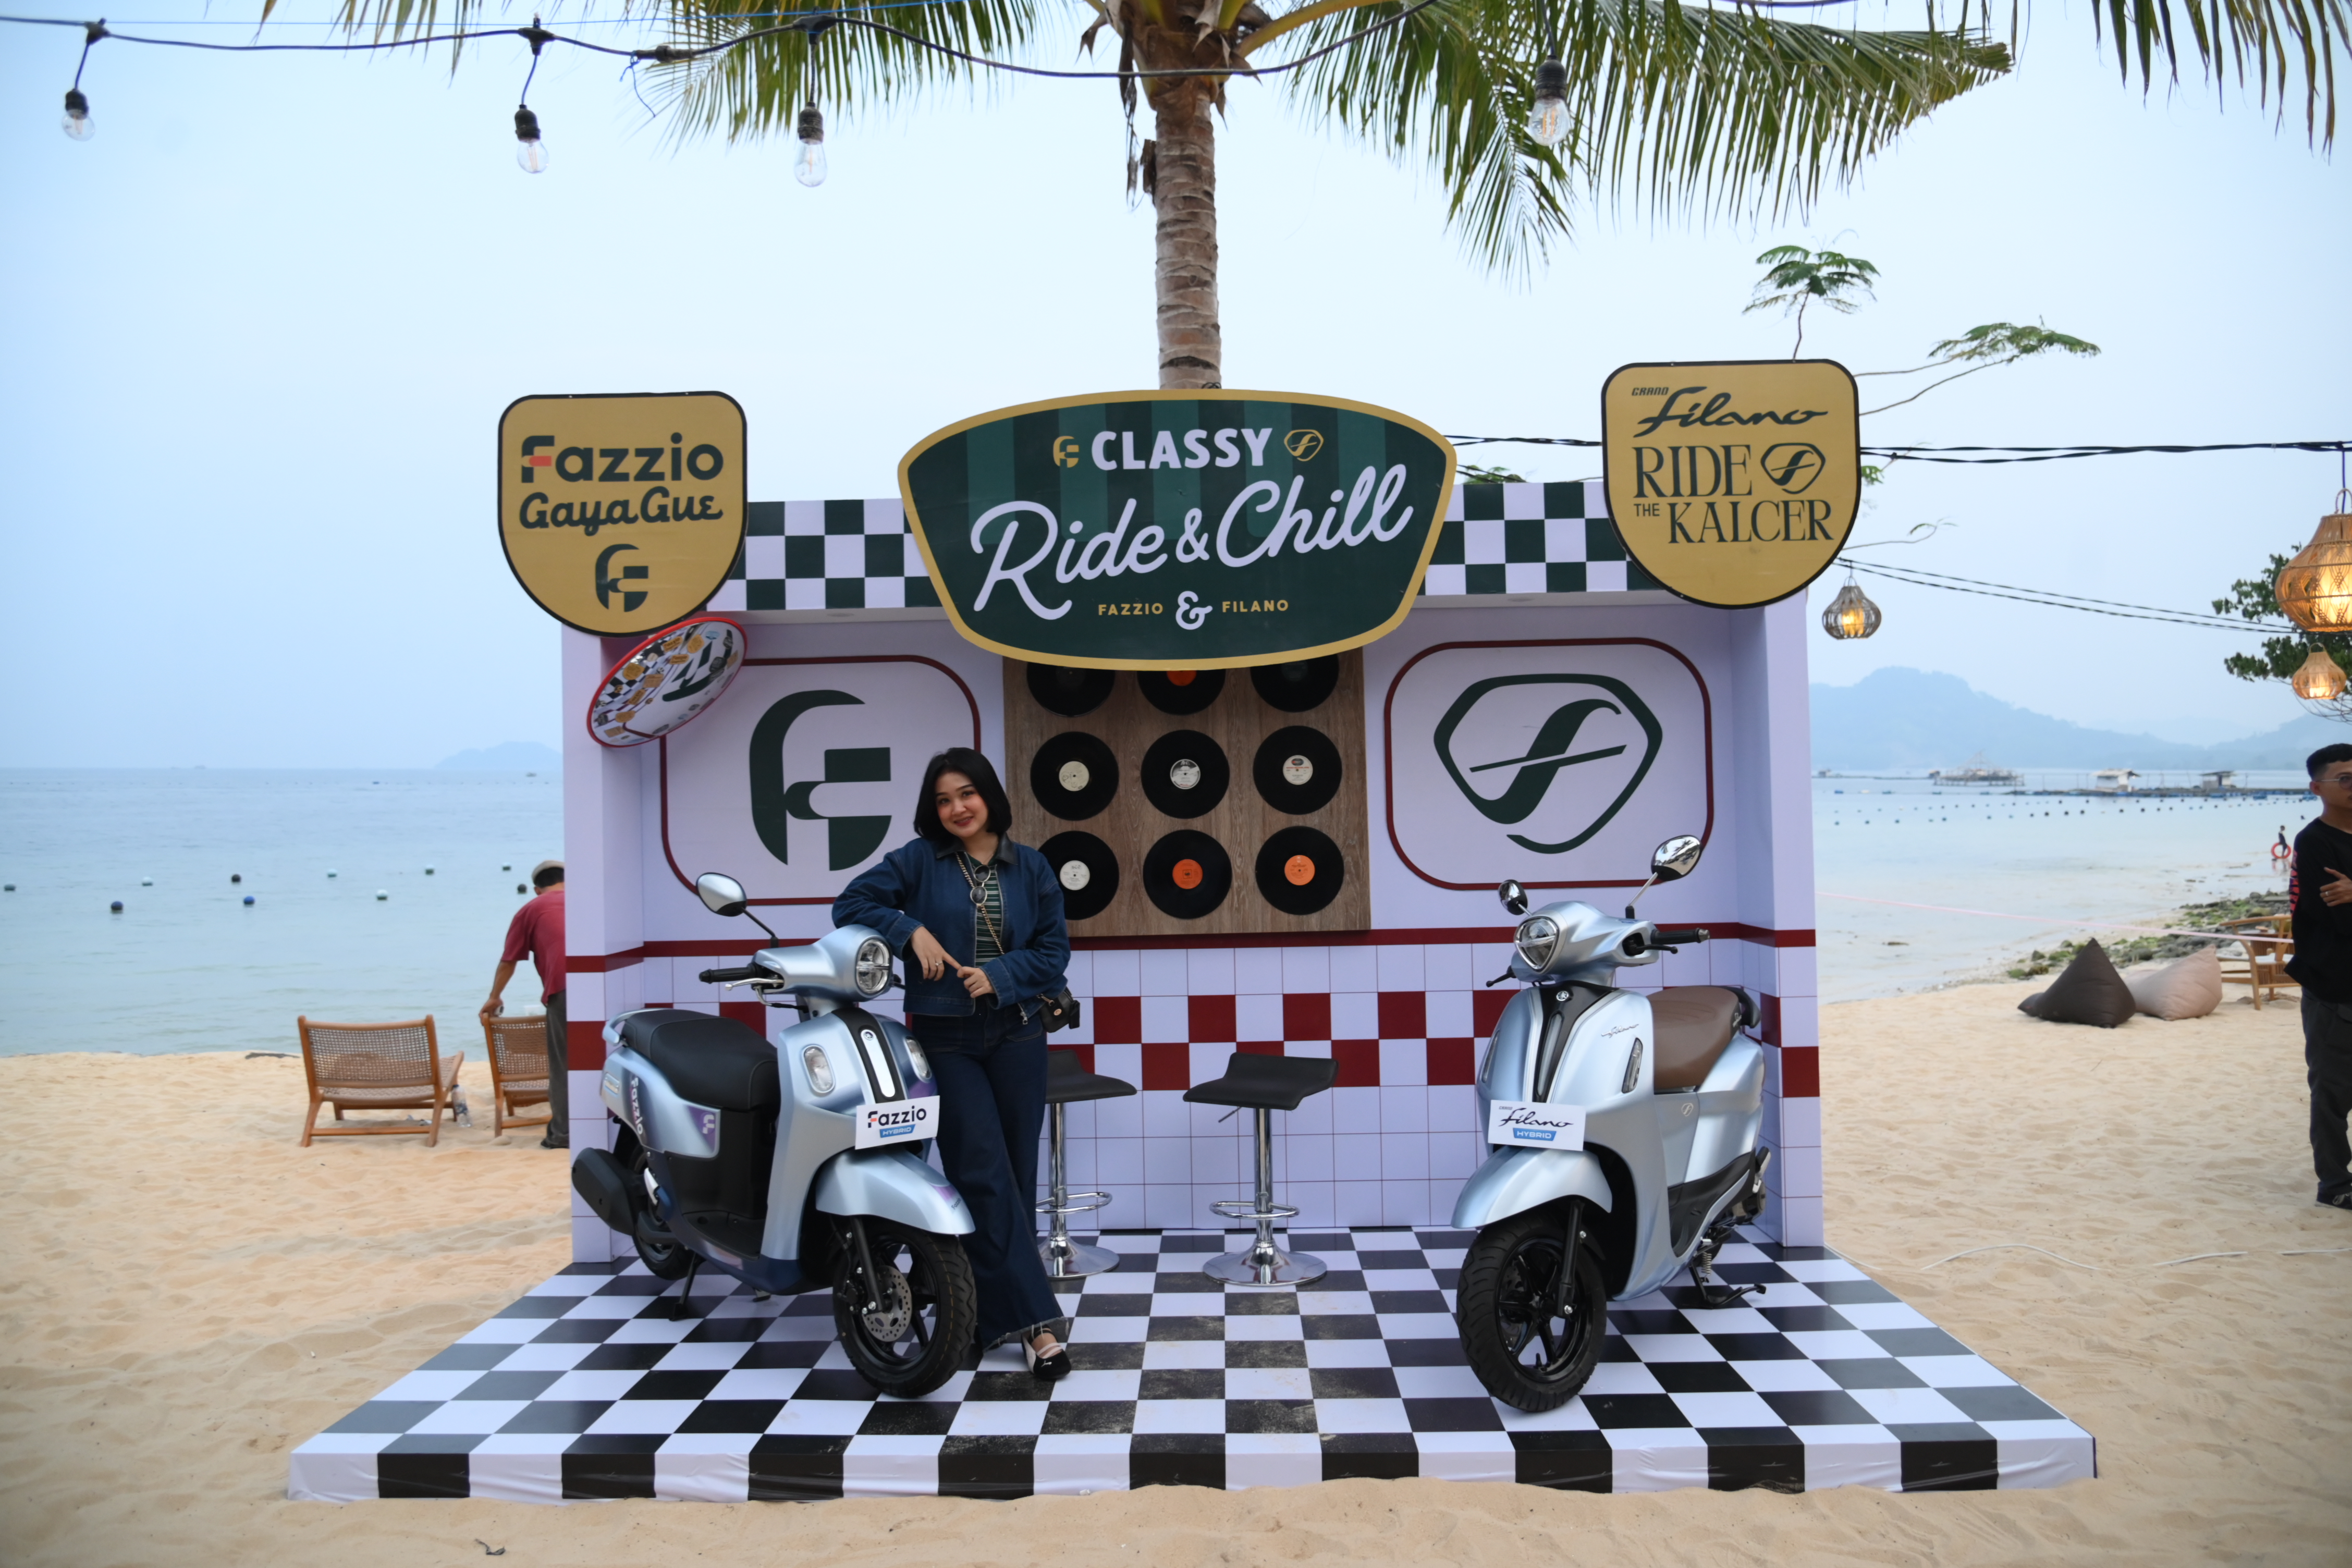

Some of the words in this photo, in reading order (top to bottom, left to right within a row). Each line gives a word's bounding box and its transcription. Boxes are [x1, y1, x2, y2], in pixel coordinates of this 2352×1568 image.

[1632, 387, 1669, 396] GRAND
[1633, 386, 1828, 438] Filano
[521, 432, 724, 483] Fazzio
[1092, 428, 1272, 471] CLASSY
[1632, 445, 1752, 498] RIDE
[971, 498, 1168, 620] Ride
[1175, 508, 1209, 563] &
[1216, 464, 1414, 567] Chill
[1633, 503, 1660, 517] THE
[1667, 499, 1834, 544] KALCER
[1098, 603, 1163, 616] FAZZIO
[1175, 591, 1213, 630] &
[1222, 599, 1289, 612] FILANO
[631, 1077, 643, 1134] Fazzio
[867, 1105, 927, 1128] Fazzio
[1498, 1108, 1574, 1128] Filano
[883, 1127, 912, 1136] HYBRID
